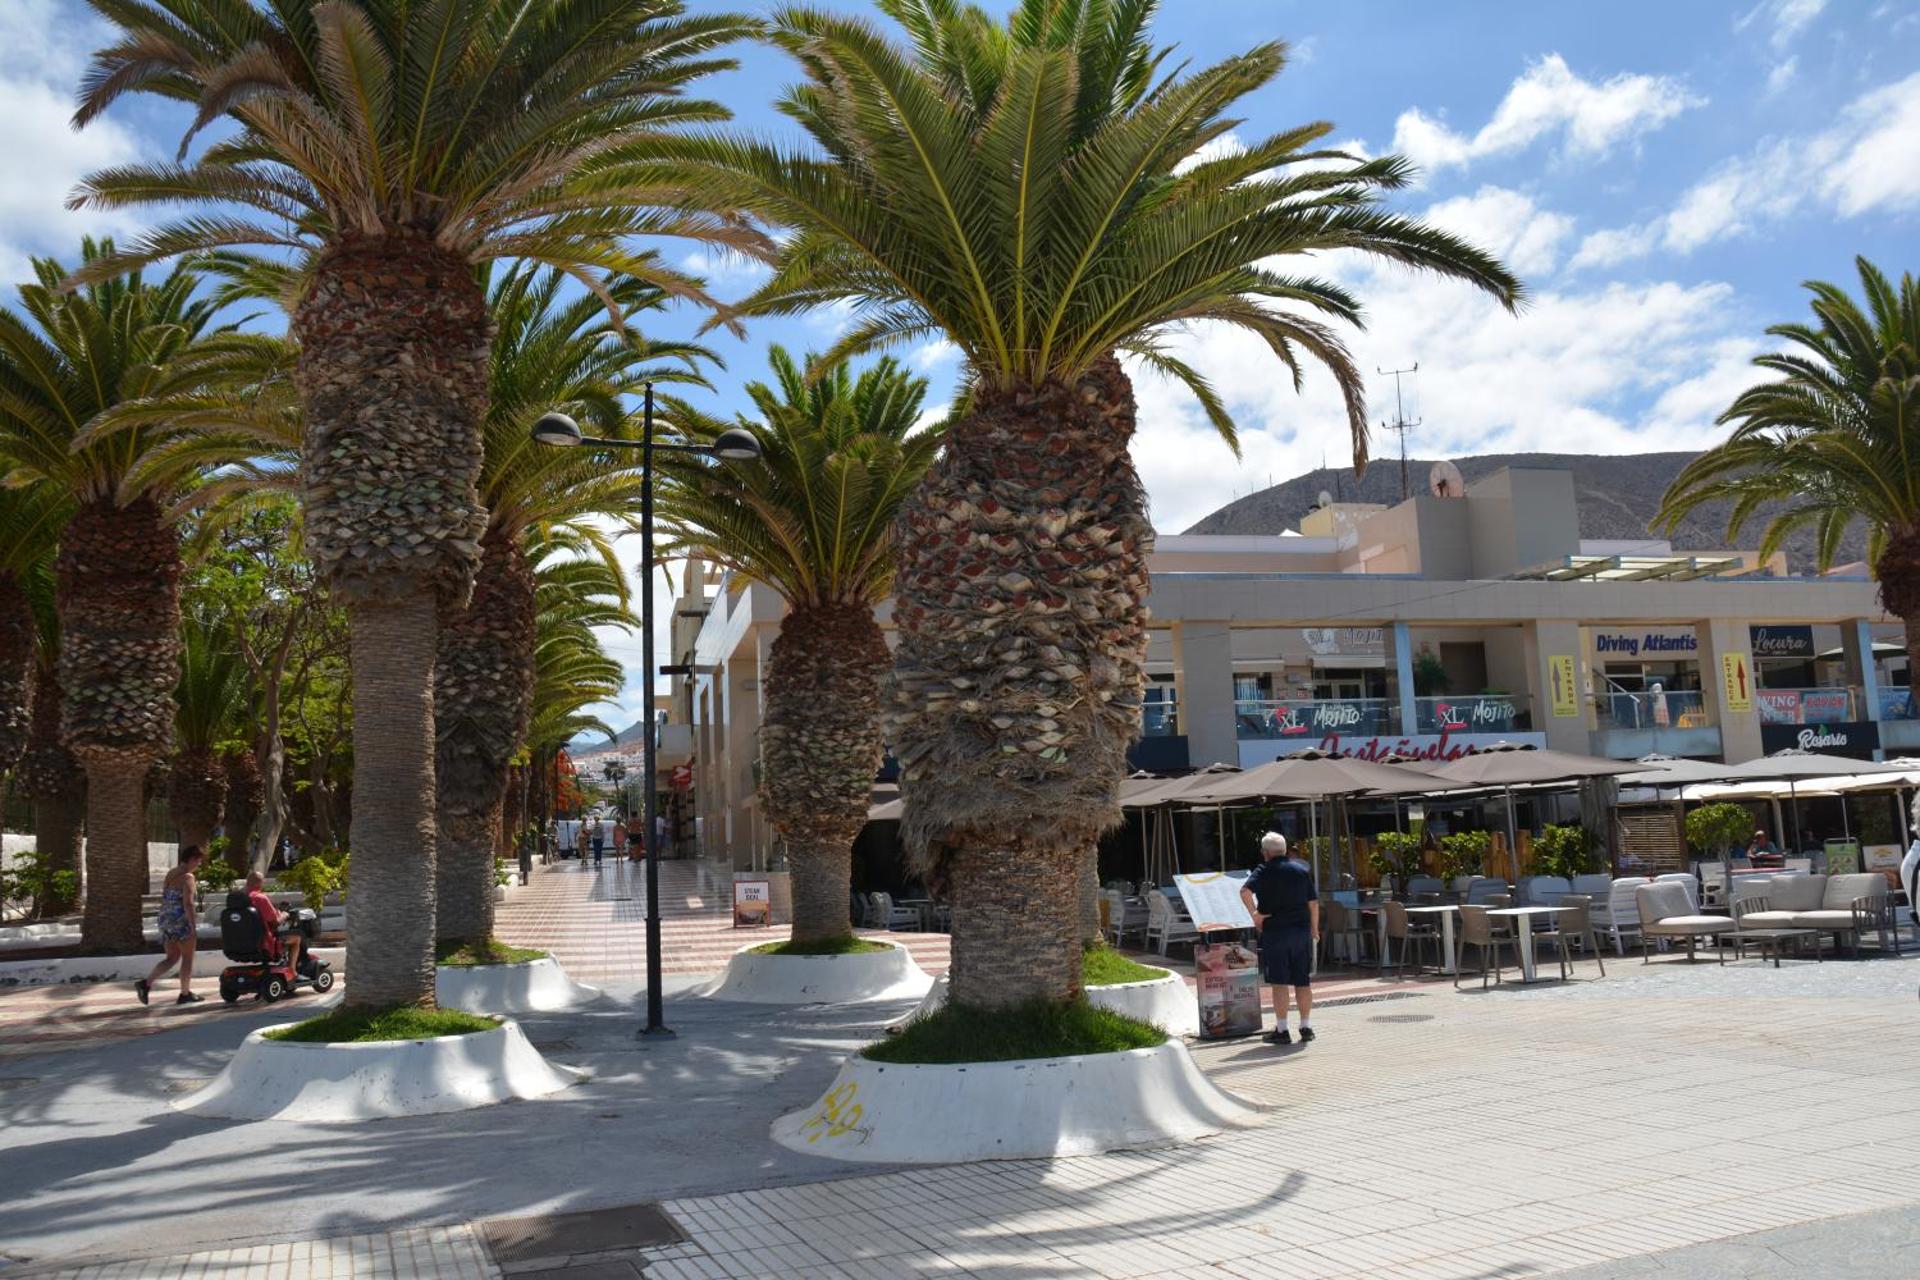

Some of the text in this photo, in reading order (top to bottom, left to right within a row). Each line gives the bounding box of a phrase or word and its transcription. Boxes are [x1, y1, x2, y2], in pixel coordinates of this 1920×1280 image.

[1597, 634, 1698, 656] Diving Atlantis
[1753, 628, 1808, 653] Locura
[1314, 704, 1360, 728] MOJITO
[1472, 700, 1516, 724] MOJITO
[1797, 729, 1847, 749] Rosario
